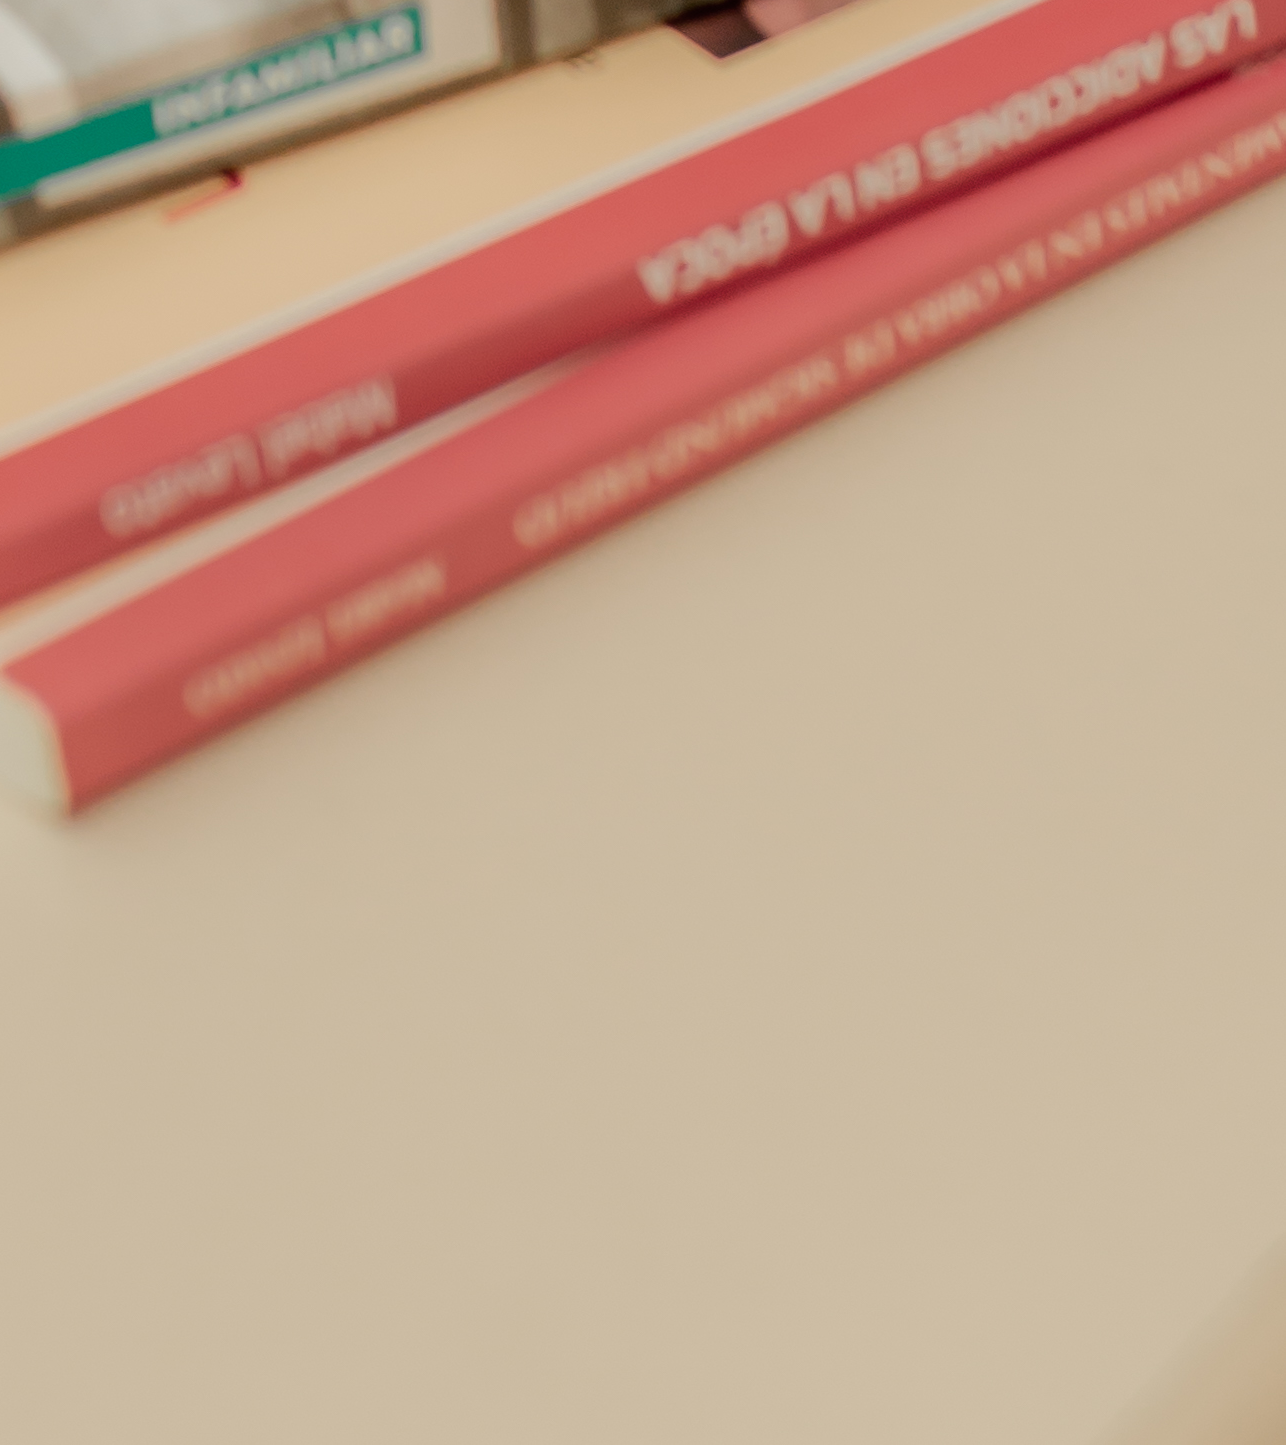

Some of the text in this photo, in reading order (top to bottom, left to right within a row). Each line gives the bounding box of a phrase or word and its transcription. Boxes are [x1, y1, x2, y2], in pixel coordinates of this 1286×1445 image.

[920, 31, 1167, 180] ADICCIONES
[788, 173, 854, 238] LA
[852, 143, 920, 213] EN
